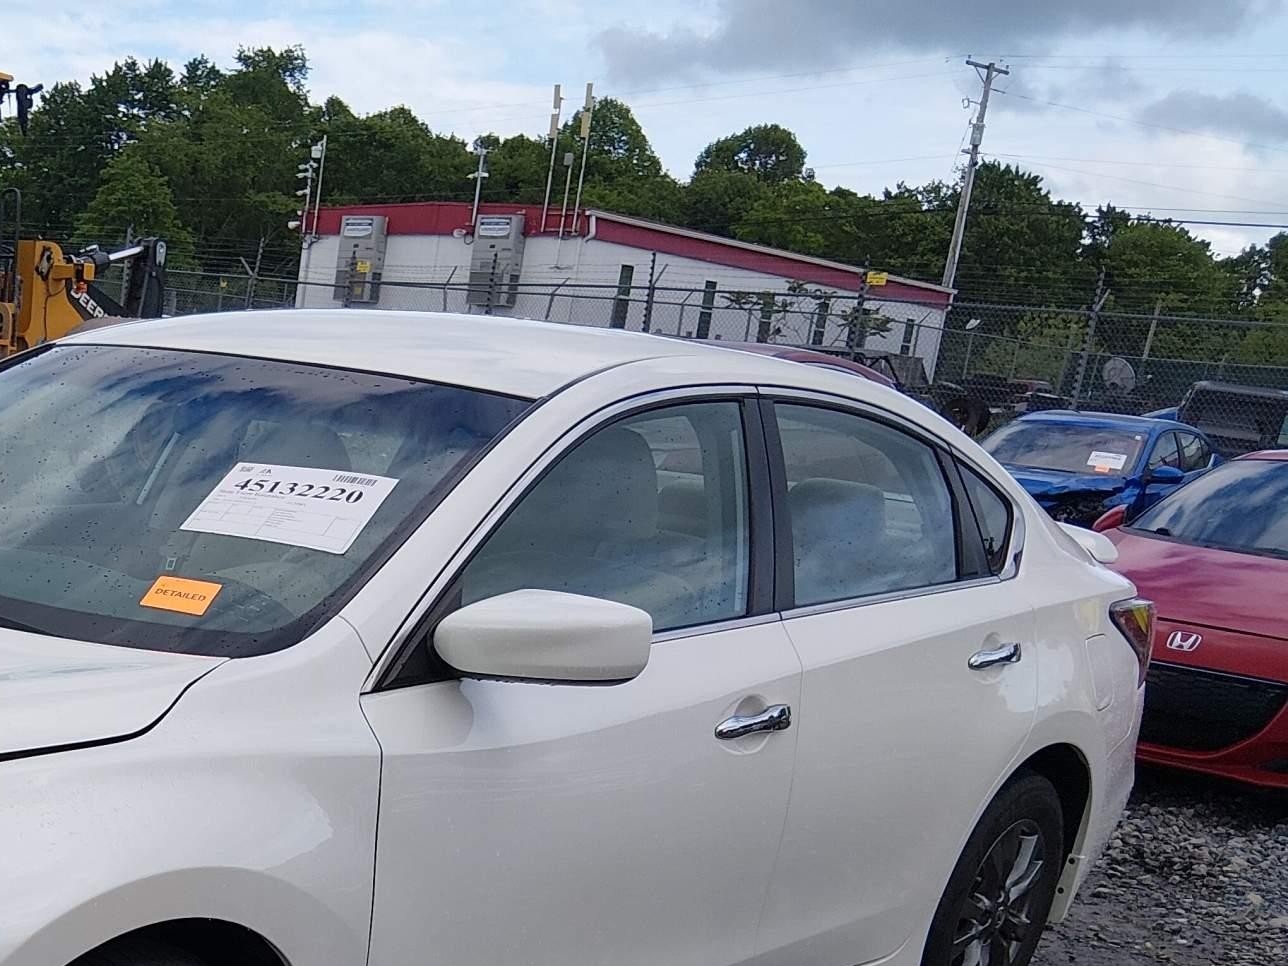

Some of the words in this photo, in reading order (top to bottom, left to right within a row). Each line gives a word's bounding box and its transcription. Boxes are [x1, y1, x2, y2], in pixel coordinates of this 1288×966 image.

[70, 288, 109, 318] DEER
[233, 478, 364, 504] 45132220
[154, 588, 207, 602] DETAILED
